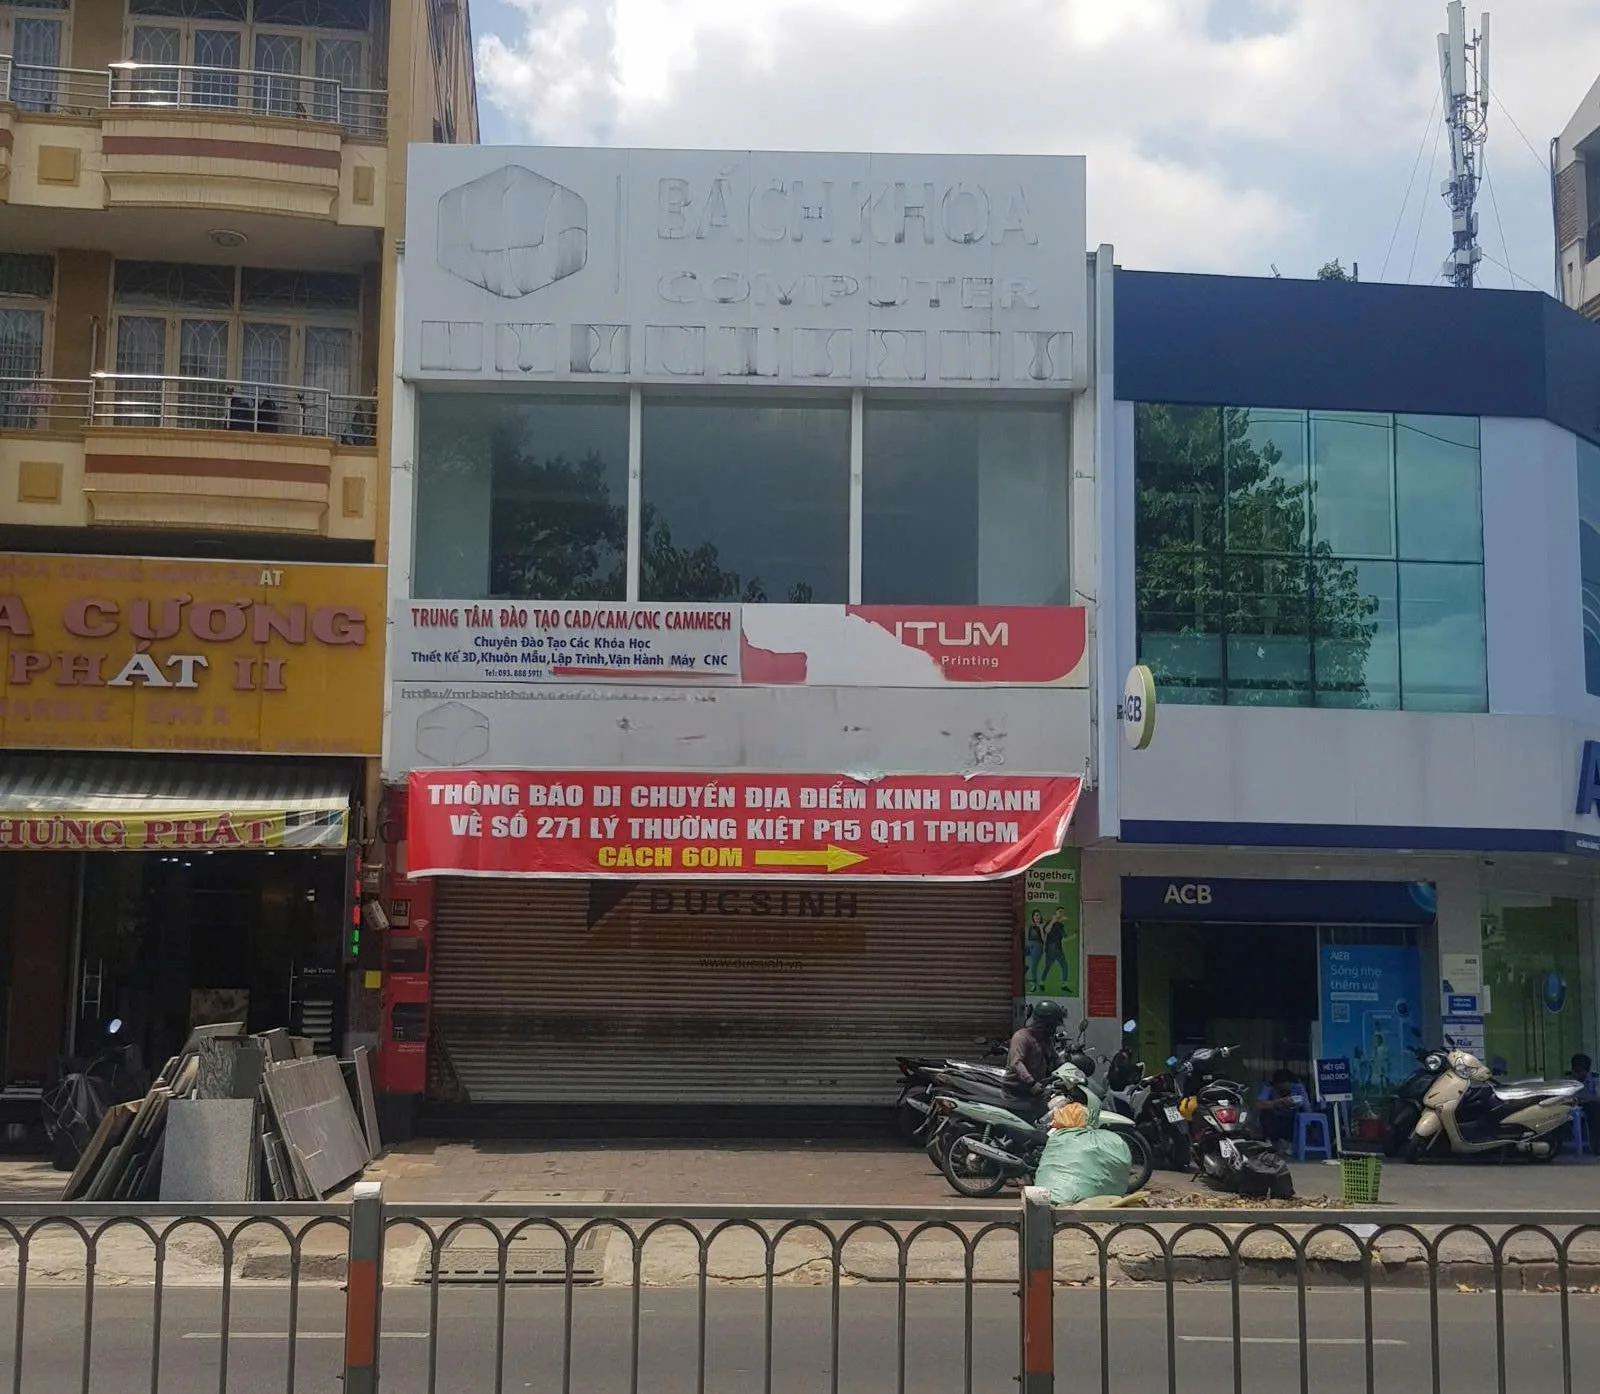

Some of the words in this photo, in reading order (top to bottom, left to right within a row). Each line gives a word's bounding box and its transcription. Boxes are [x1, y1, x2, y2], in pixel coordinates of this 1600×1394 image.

[851, 179, 1039, 246] KHOA
[657, 270, 1040, 309] COMPUTER
[411, 607, 459, 629] TRUNG
[464, 605, 493, 629] TÂM
[499, 605, 528, 629] ĐÀO
[534, 609, 560, 632] TẠO
[564, 611, 660, 631] CAD/CAM/CNC
[664, 611, 731, 631] CAMMECH
[474, 636, 517, 652] Chuyên
[522, 637, 544, 649] Đào
[547, 637, 568, 653] Tạo
[570, 636, 590, 650] Các
[594, 637, 625, 651] Khóa
[629, 637, 651, 653] Học
[895, 621, 1009, 646] TUM
[9, 640, 208, 688] PHÁT
[411, 650, 441, 663] Thiết
[444, 650, 460, 663] Kế
[462, 651, 517, 665] 3D,Khuôn
[633, 653, 664, 666] Hành
[670, 654, 696, 668] Máy
[703, 654, 728, 666] CNC
[941, 655, 999, 668] Printing
[428, 780, 520, 806] THÔNG
[529, 782, 584, 807] BÁO
[593, 786, 621, 807] DI
[745, 787, 791, 812] ĐỊA
[800, 781, 866, 810] ĐIỂM
[876, 789, 940, 810] KINH
[950, 789, 1041, 812] DOANH
[491, 808, 529, 838] SỐ
[537, 817, 581, 839] 271
[590, 813, 619, 840] LÝ
[628, 815, 737, 840] THƯỜNG
[747, 816, 804, 845] KIỆT
[813, 819, 862, 841] P15
[871, 819, 915, 843] Q11
[924, 821, 1019, 844] TPHCM
[598, 844, 672, 868] CÁCH
[681, 847, 742, 868] 60M
[1027, 870, 1074, 881] Together,
[651, 889, 857, 918] DUCSINH
[1164, 884, 1213, 905] ACB
